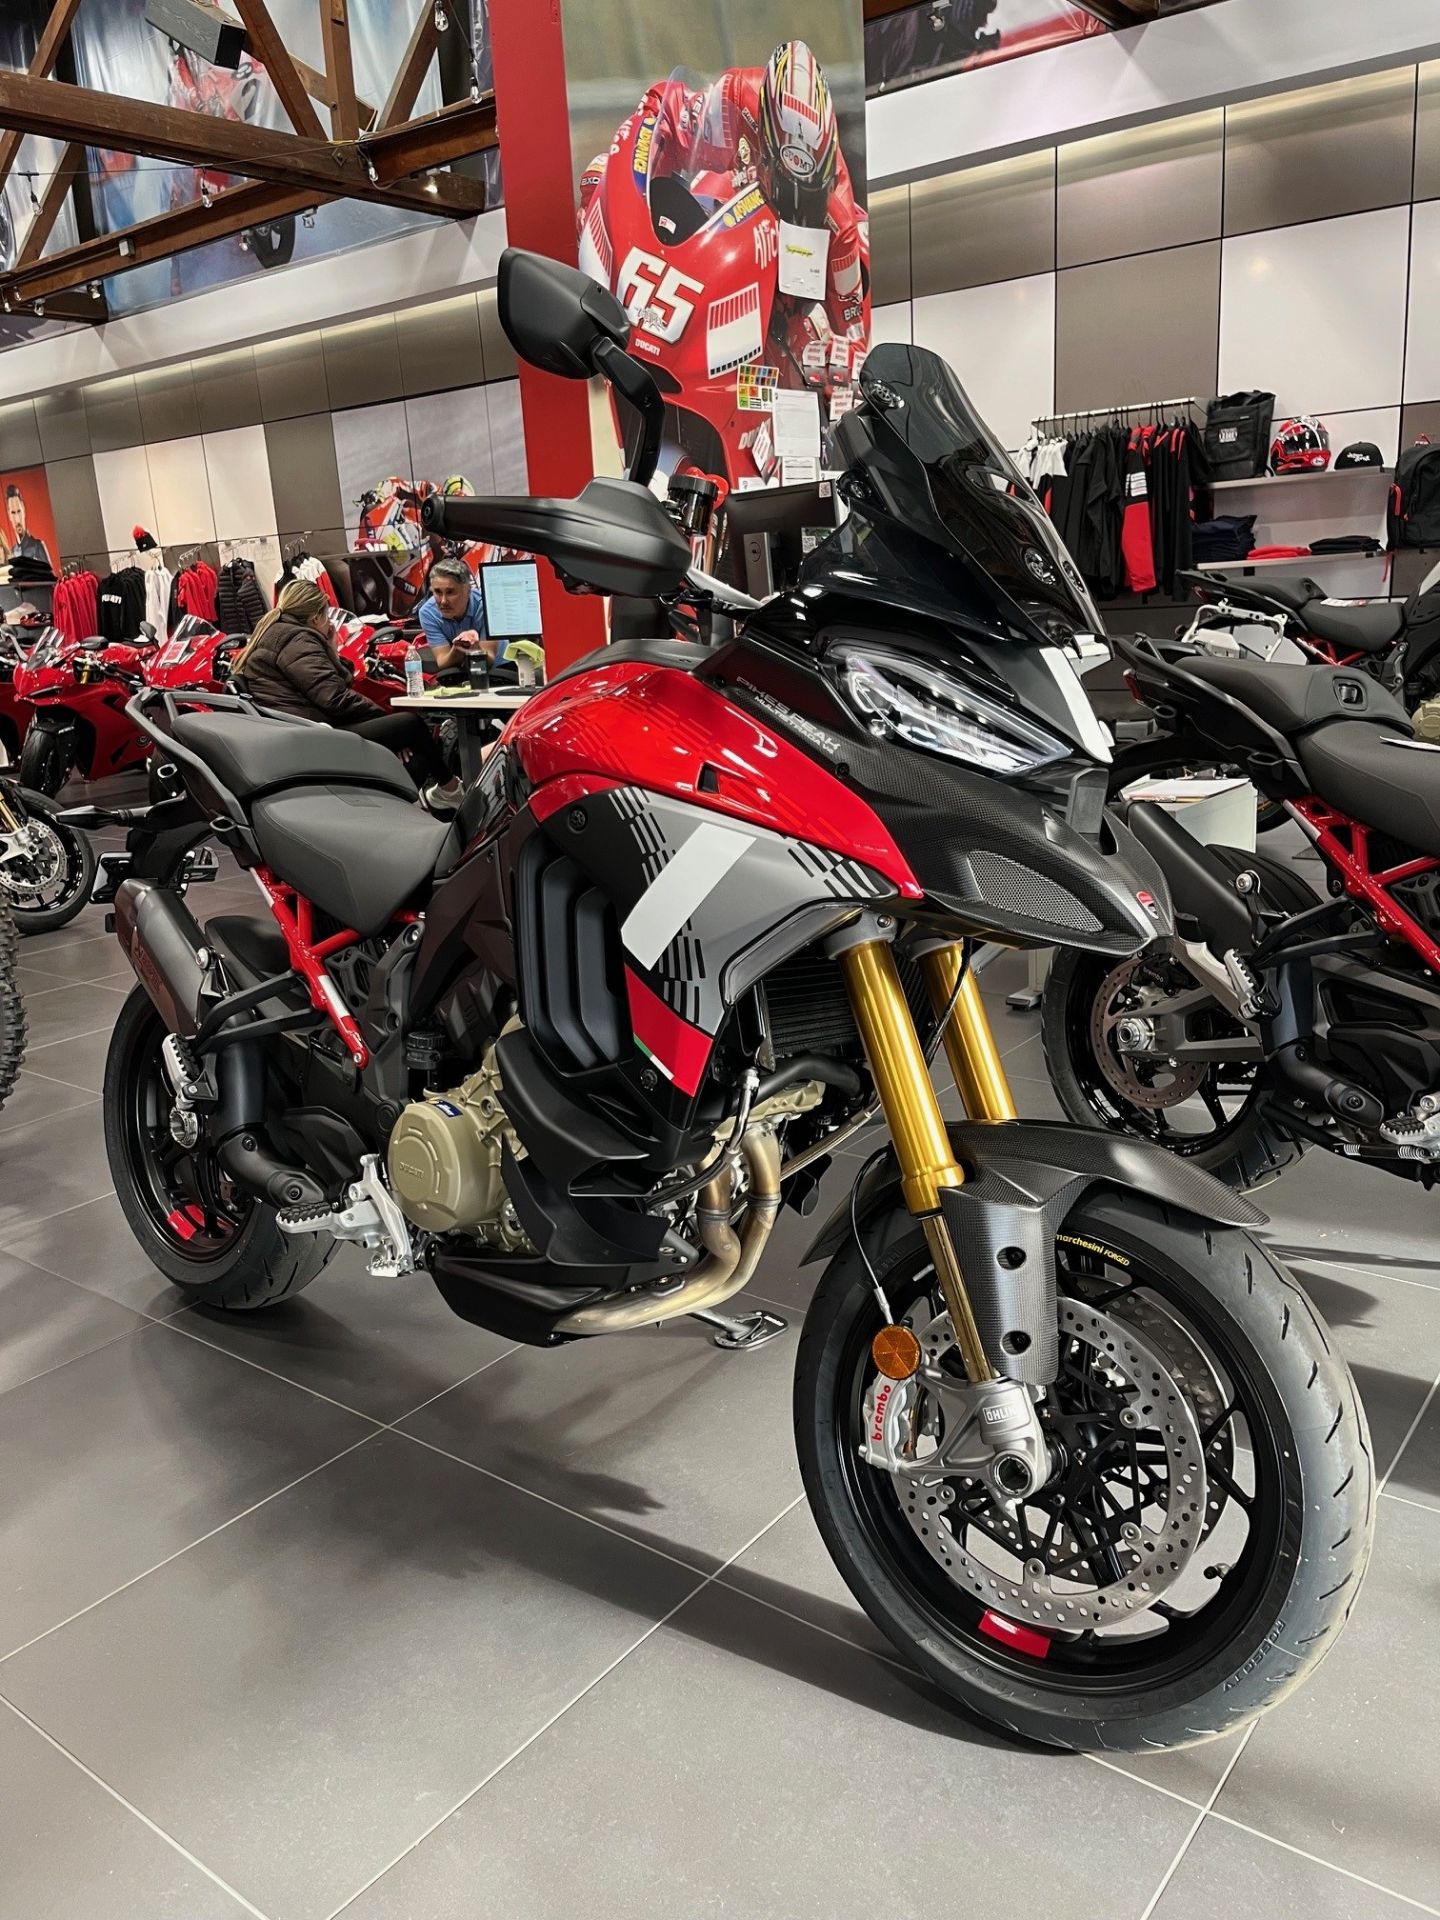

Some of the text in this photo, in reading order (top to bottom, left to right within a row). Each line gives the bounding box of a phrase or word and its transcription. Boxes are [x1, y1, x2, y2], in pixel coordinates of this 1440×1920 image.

[616, 246, 705, 345] 65
[635, 338, 661, 356] DUCATI
[737, 676, 841, 751] PIKES PEAK
[754, 695, 821, 746] MULTISTRADA
[1104, 1249, 1131, 1266] FORGED
[871, 1384, 892, 1441] brembo
